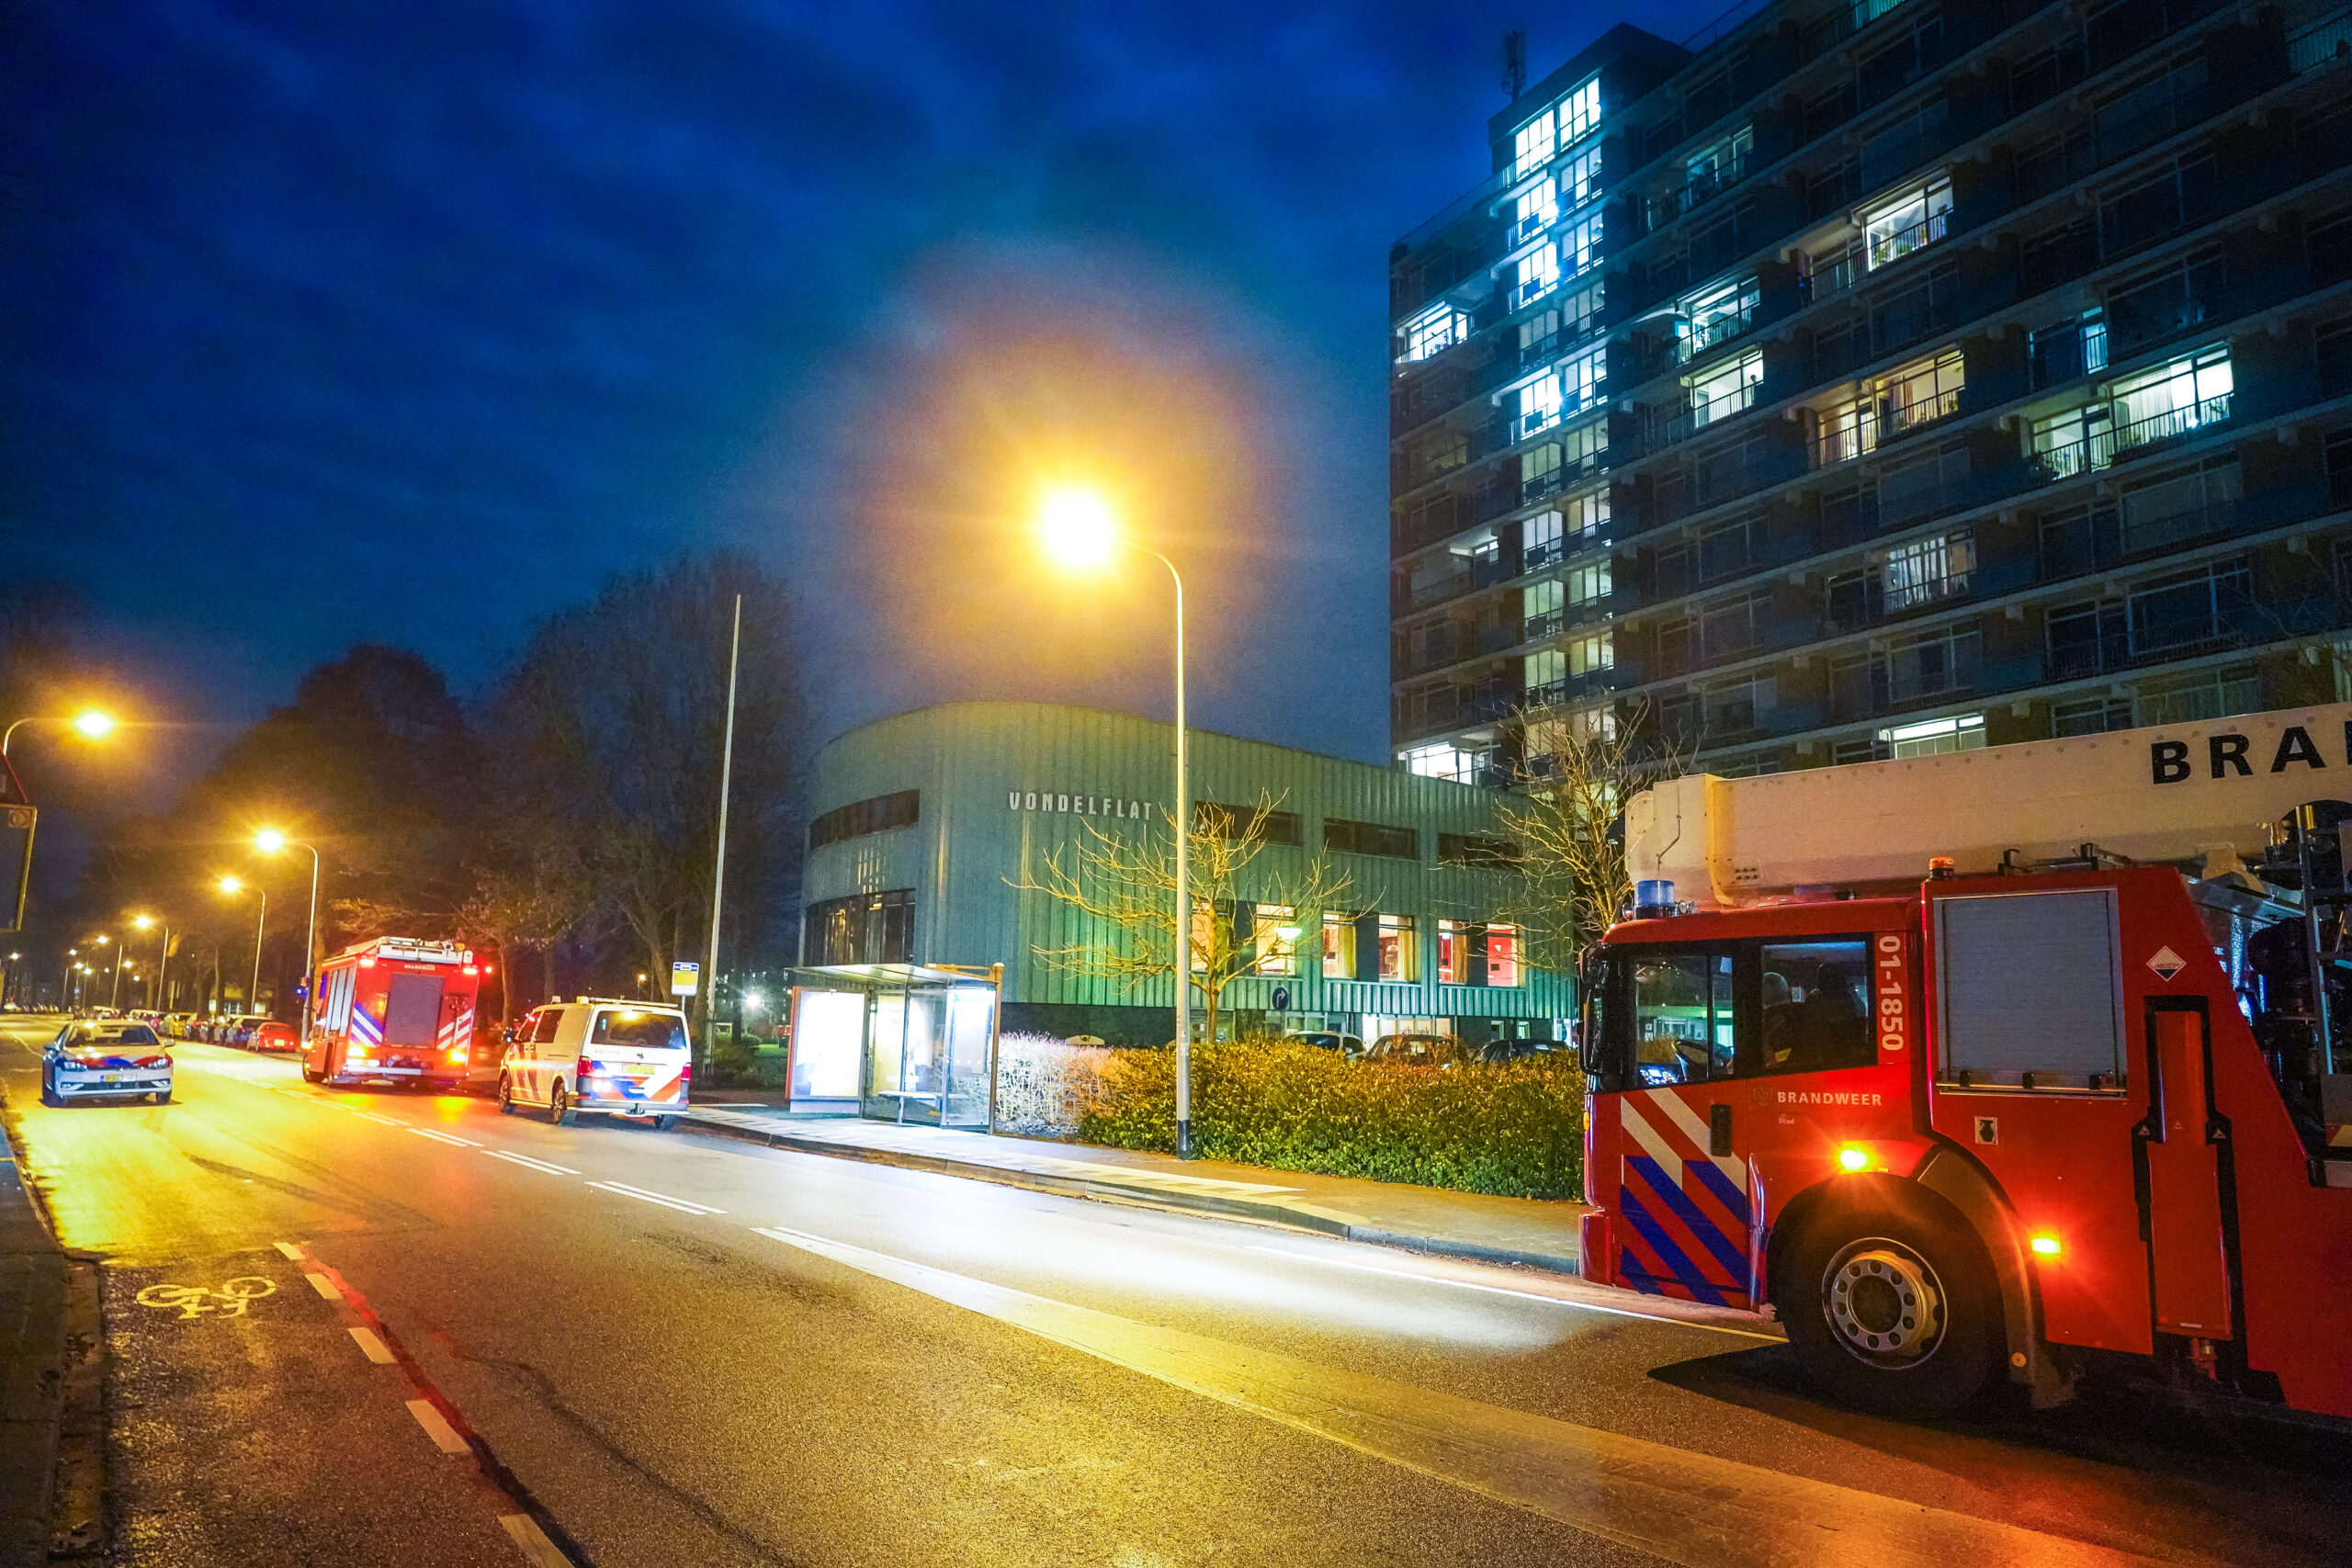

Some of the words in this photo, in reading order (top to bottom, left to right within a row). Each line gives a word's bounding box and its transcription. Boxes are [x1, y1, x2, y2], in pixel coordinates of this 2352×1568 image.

[2151, 721, 2352, 784] BRA
[1009, 792, 1152, 820] VONDELFLAT
[1879, 935, 1904, 1051] 01-1850
[1777, 1091, 1883, 1106] BRANDWEER
